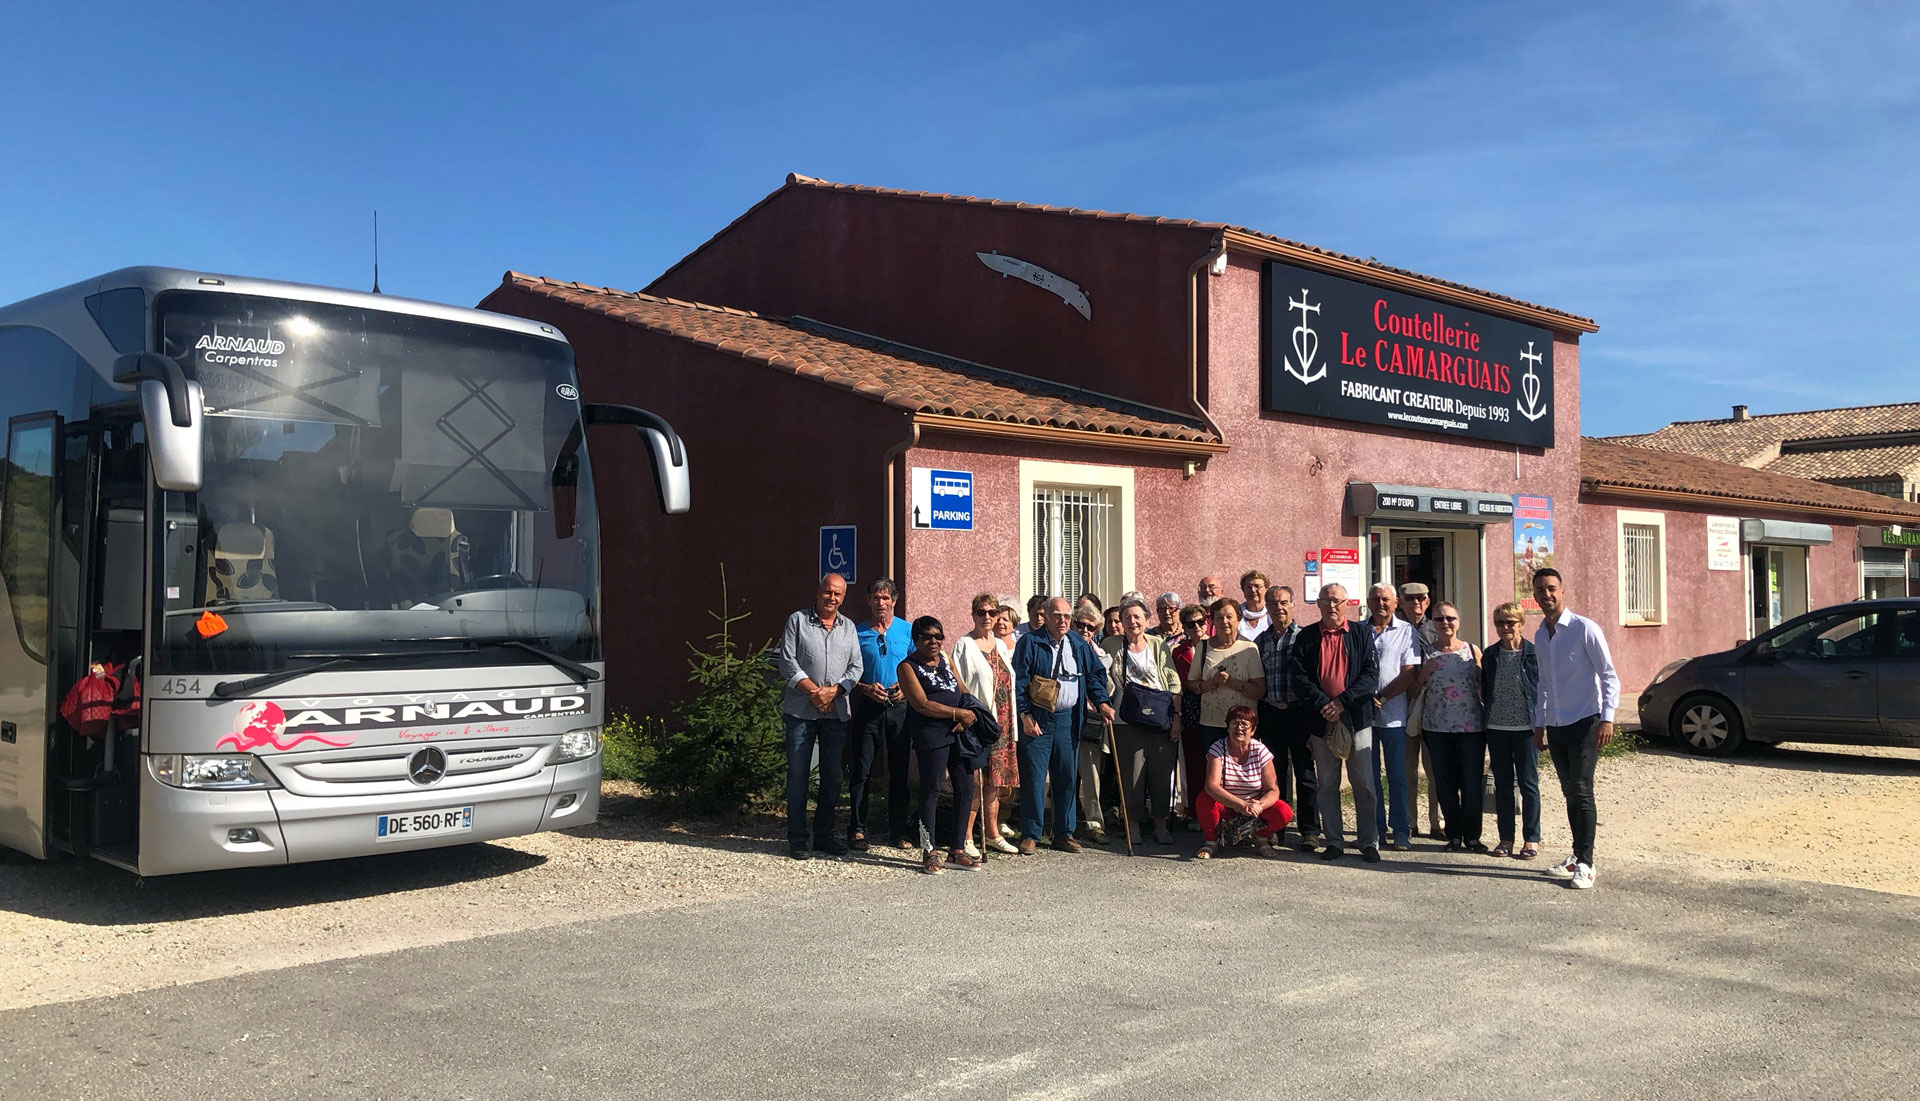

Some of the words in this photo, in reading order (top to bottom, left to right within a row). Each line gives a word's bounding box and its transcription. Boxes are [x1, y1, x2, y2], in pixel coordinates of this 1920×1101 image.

[1373, 298, 1480, 352] Coutellerie
[195, 334, 285, 355] ARNAUD
[204, 351, 278, 367] Carpentras
[1340, 331, 1367, 368] Le
[1374, 339, 1511, 394] CAMARGUAIS
[1341, 380, 1401, 405] FABRICANT
[1402, 391, 1454, 414] CREATEUR
[1455, 399, 1487, 421] Depuis
[1487, 405, 1510, 423] 1993
[1387, 411, 1468, 430] www.lecouteaucamarguais.com
[1382, 496, 1391, 506] 200
[933, 510, 971, 521] PARKING
[162, 679, 201, 695] 454
[301, 686, 586, 707] VOYAGES
[285, 696, 585, 728] ARNAUD
[523, 709, 585, 720] CARPENTRAS
[398, 728, 441, 741] Voyager
[475, 723, 510, 734] ailleurs
[458, 752, 524, 765] TOURISMO
[389, 811, 462, 834] DE-560-RF
